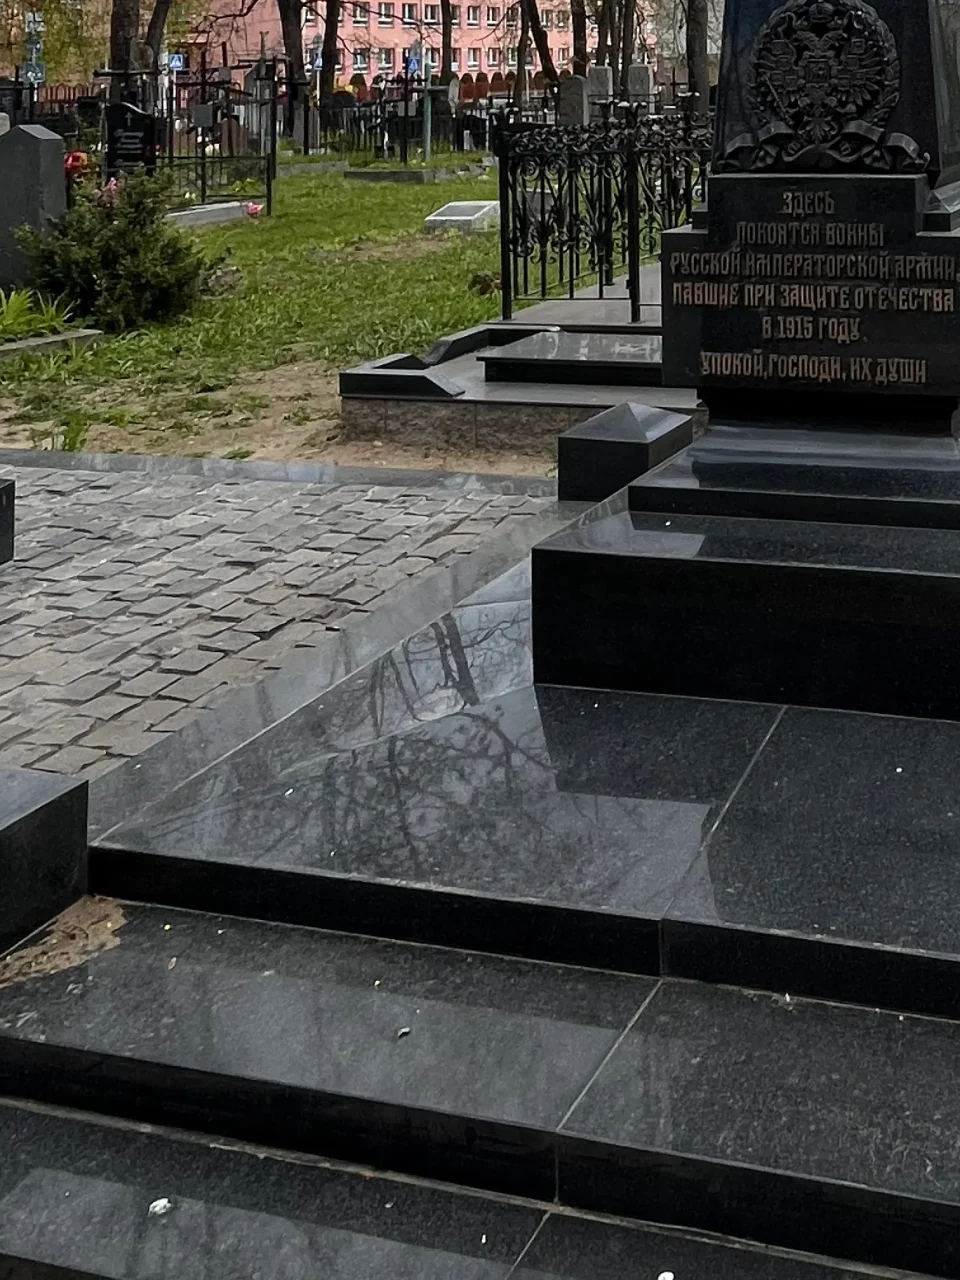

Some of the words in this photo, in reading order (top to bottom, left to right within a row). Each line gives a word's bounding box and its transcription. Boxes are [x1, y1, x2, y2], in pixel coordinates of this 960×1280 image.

[782, 191, 835, 217] ЗДЕСЬ
[736, 222, 820, 246] ПОКОЯТСЯ
[826, 223, 884, 248] ВОИНЫ
[670, 247, 740, 275] РУССКОЙ
[745, 251, 889, 280] ИМПЕРАТОРСКОЙ
[673, 281, 739, 308] ПАВШИЕ
[744, 284, 775, 306] ПРИ
[780, 284, 849, 311] ЗАЩИТЕ
[855, 285, 954, 312] ОТЕЧЕСТВА
[762, 316, 772, 339] В
[777, 316, 813, 339] 1915
[850, 357, 873, 381] ИХ
[875, 358, 926, 386] ДУШИ
